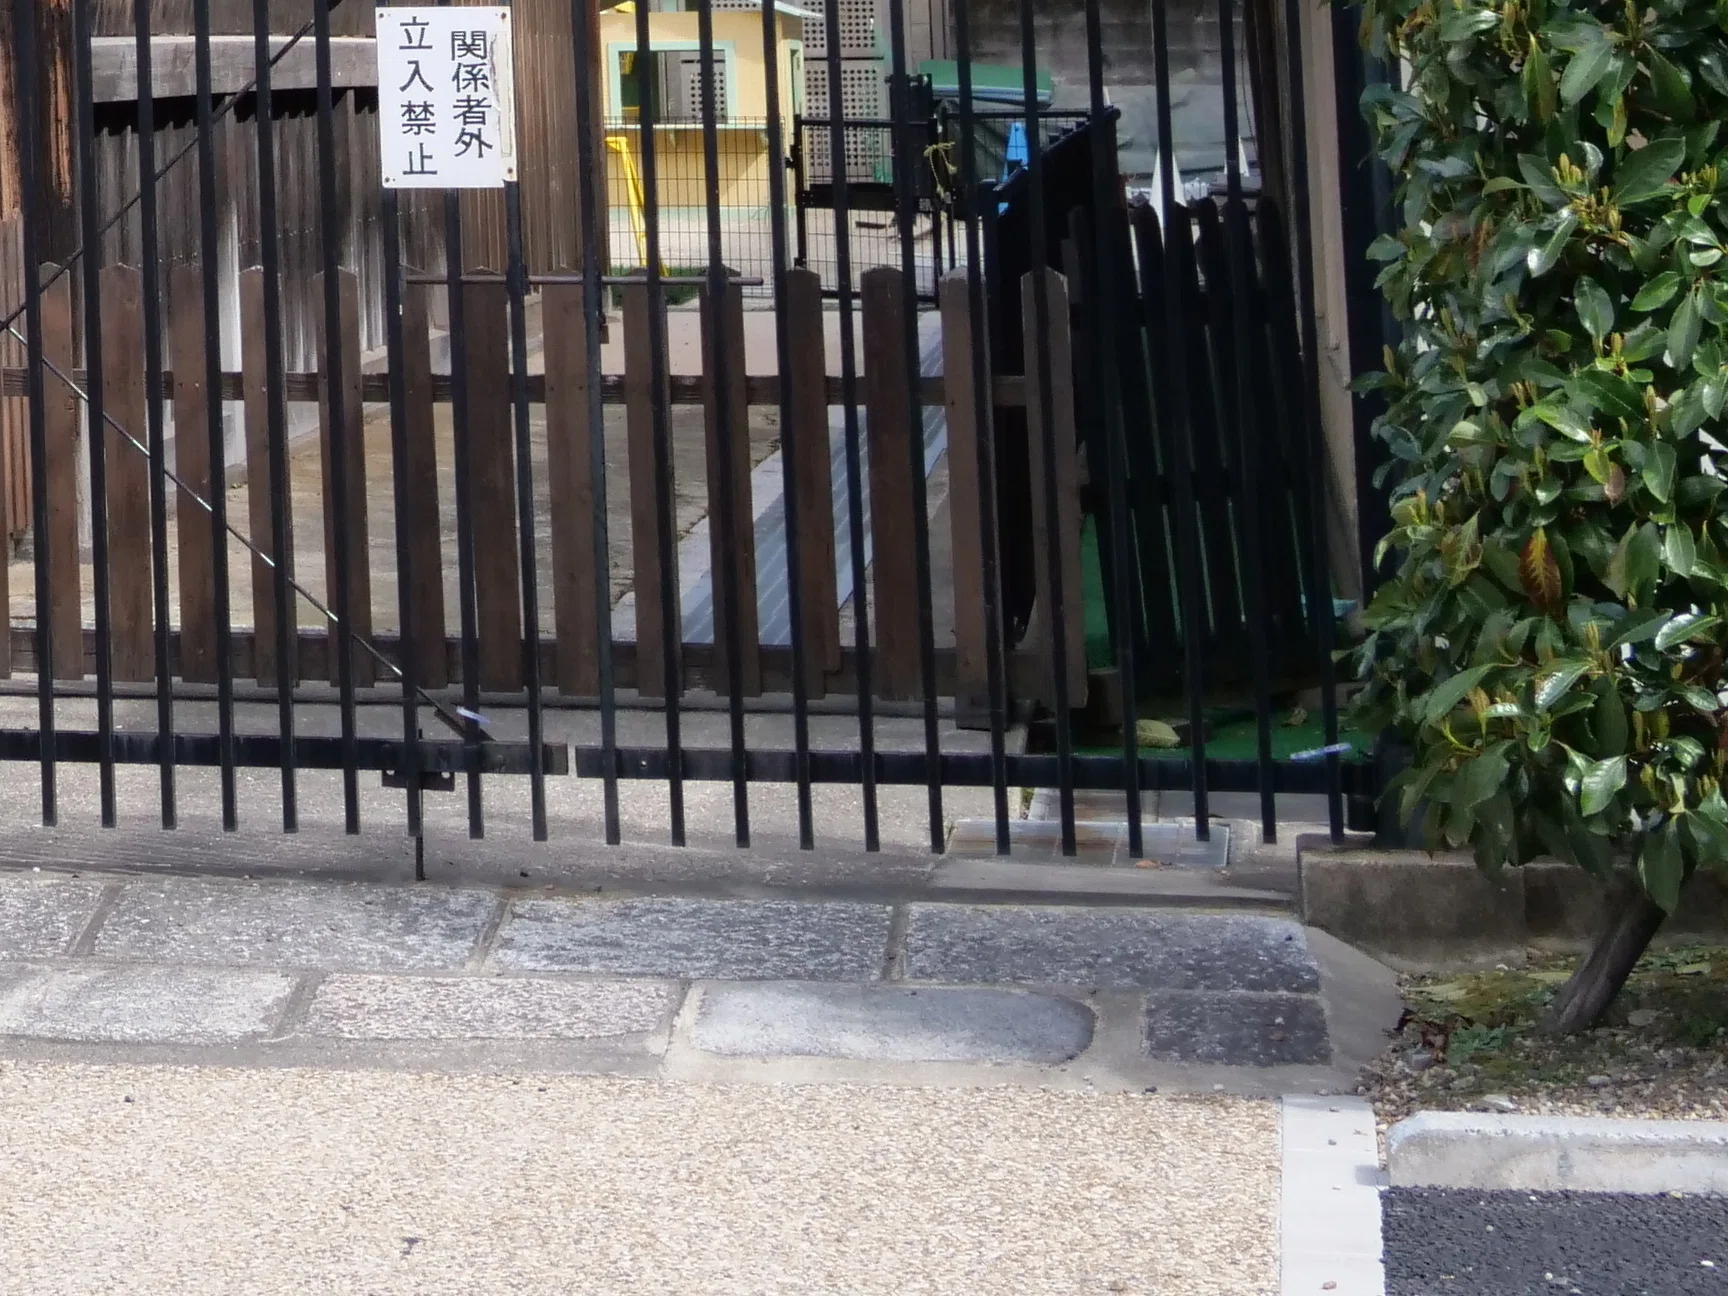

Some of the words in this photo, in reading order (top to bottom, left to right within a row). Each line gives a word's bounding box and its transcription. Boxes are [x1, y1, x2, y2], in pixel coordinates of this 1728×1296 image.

[399, 16, 438, 176] 立入禁止
[451, 30, 493, 159] 関係者外
